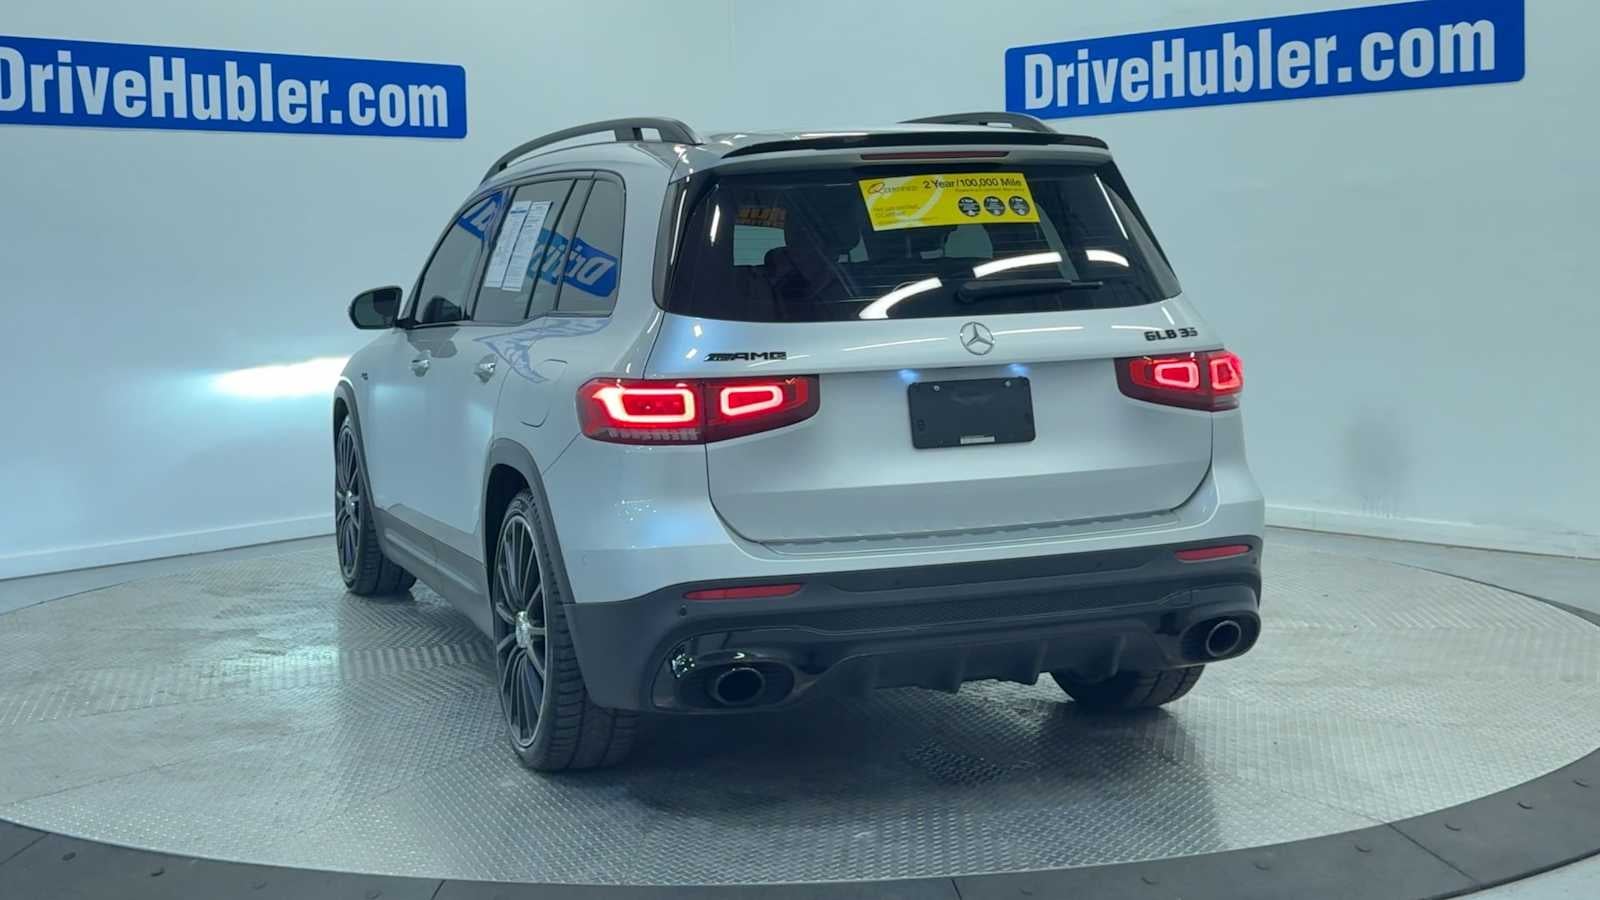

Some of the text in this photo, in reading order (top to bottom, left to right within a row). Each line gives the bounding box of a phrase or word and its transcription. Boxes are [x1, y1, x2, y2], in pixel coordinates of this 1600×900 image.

[1023, 18, 1496, 109] DriveHubler.com
[0, 45, 449, 128] DriveHubler.com
[922, 181, 931, 189] 2
[1000, 178, 1022, 187] Mile
[1143, 327, 1198, 341] GLB 35
[730, 351, 787, 361] AMG
